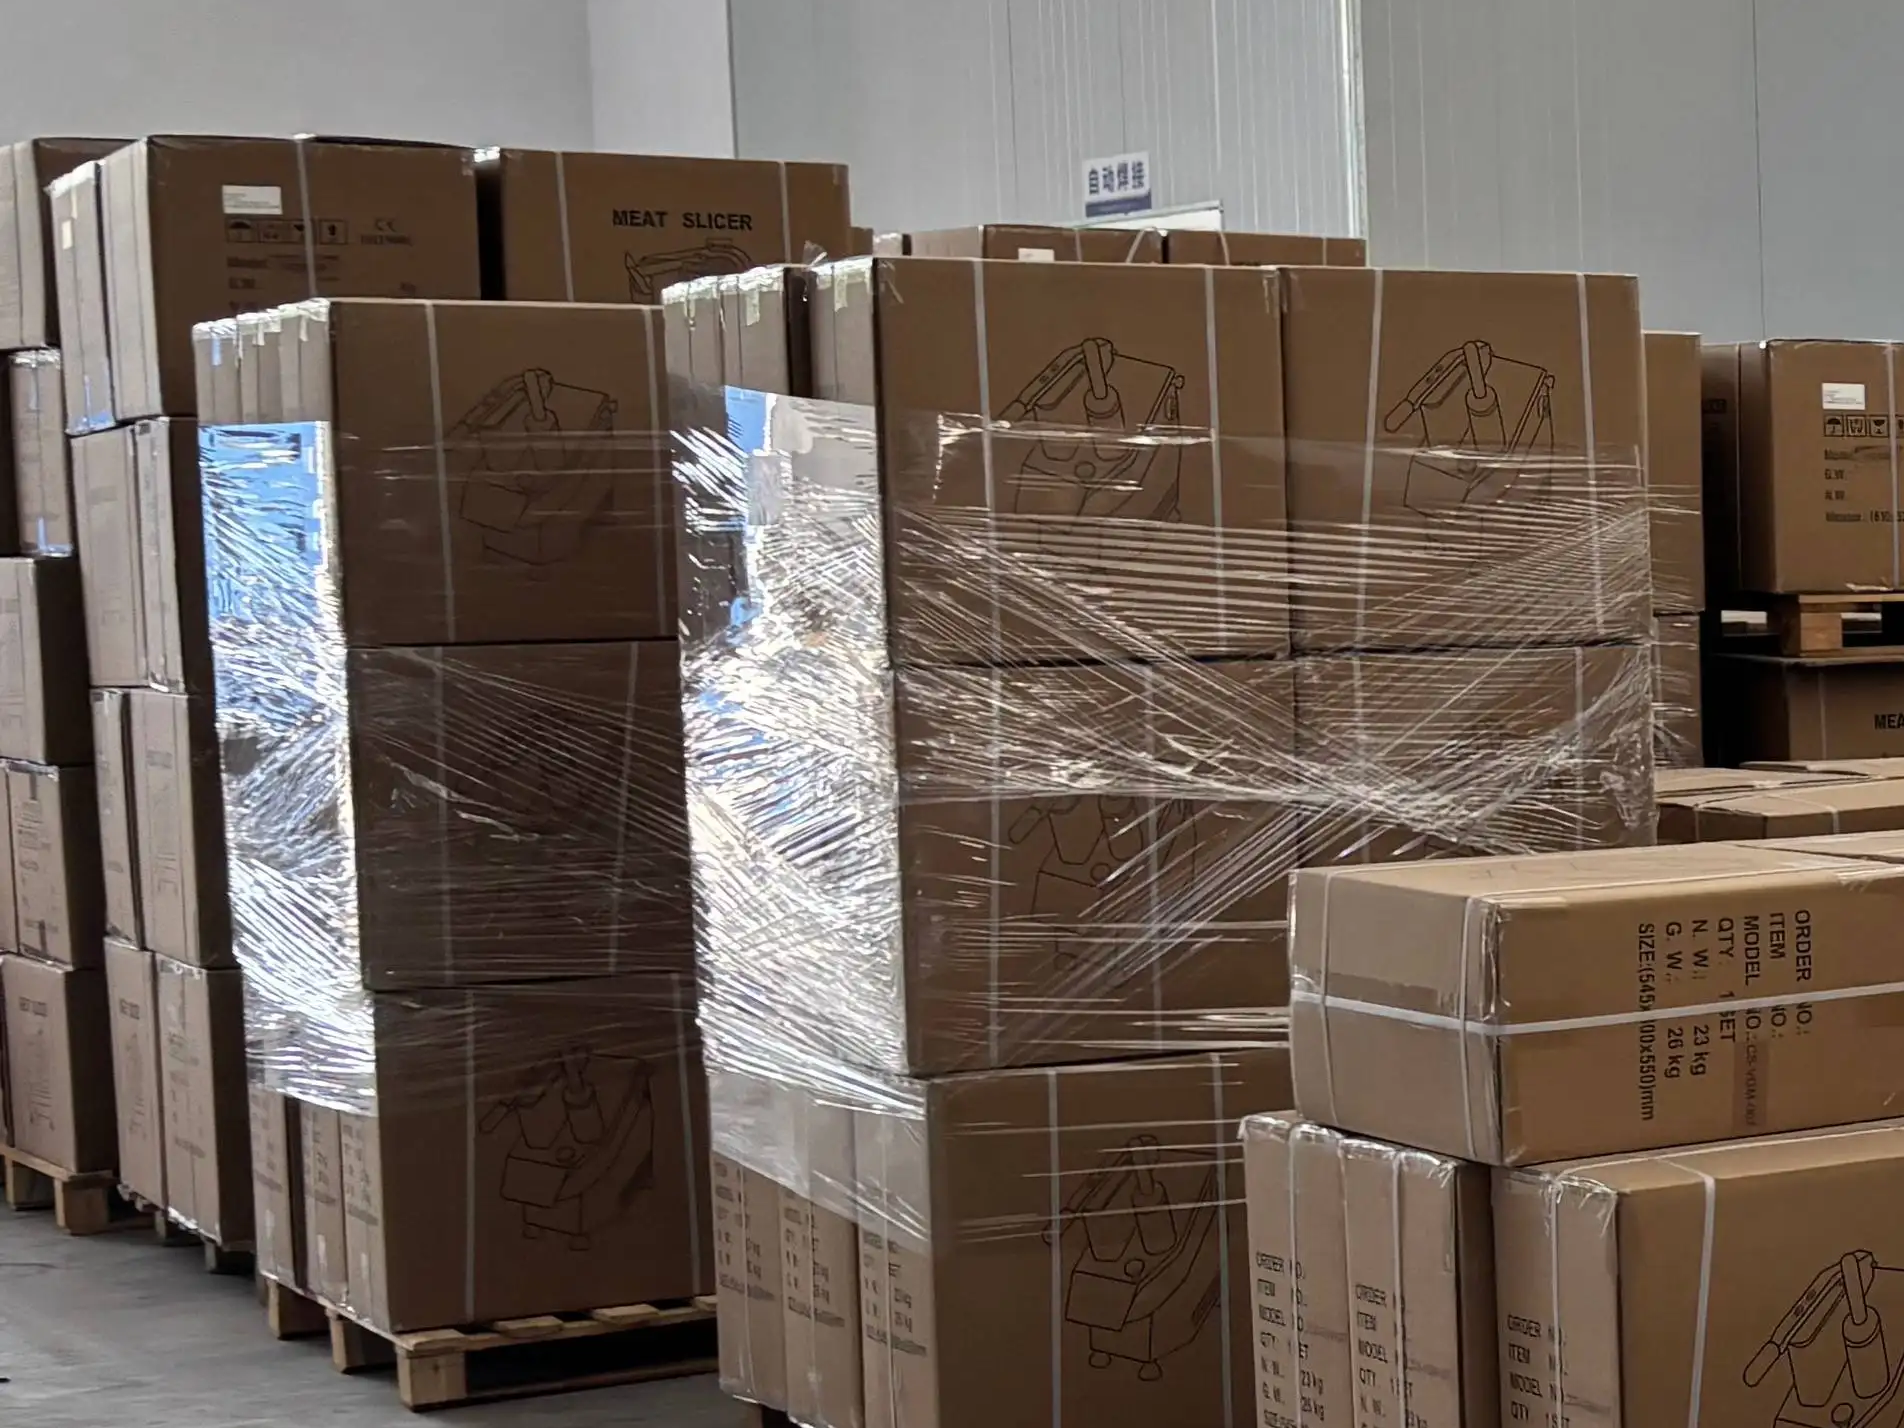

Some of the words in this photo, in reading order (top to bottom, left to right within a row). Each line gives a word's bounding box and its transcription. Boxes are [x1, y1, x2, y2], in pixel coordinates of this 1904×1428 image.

[1088, 159, 1144, 195] 自动焊接
[612, 209, 667, 228] MEAT
[682, 212, 752, 231] SLICER
[1769, 912, 1786, 960] ITEM
[1794, 909, 1812, 982] ORDER
[1744, 915, 1760, 986] MODEL
[1718, 991, 1735, 999] 1
[1668, 1027, 1683, 1050] 26
[1694, 1025, 1709, 1048] 23
[1664, 1054, 1684, 1079] kg
[1690, 1051, 1710, 1076] kg
[1508, 1343, 1531, 1364] ITEM
[1510, 1372, 1543, 1398] MODEL
